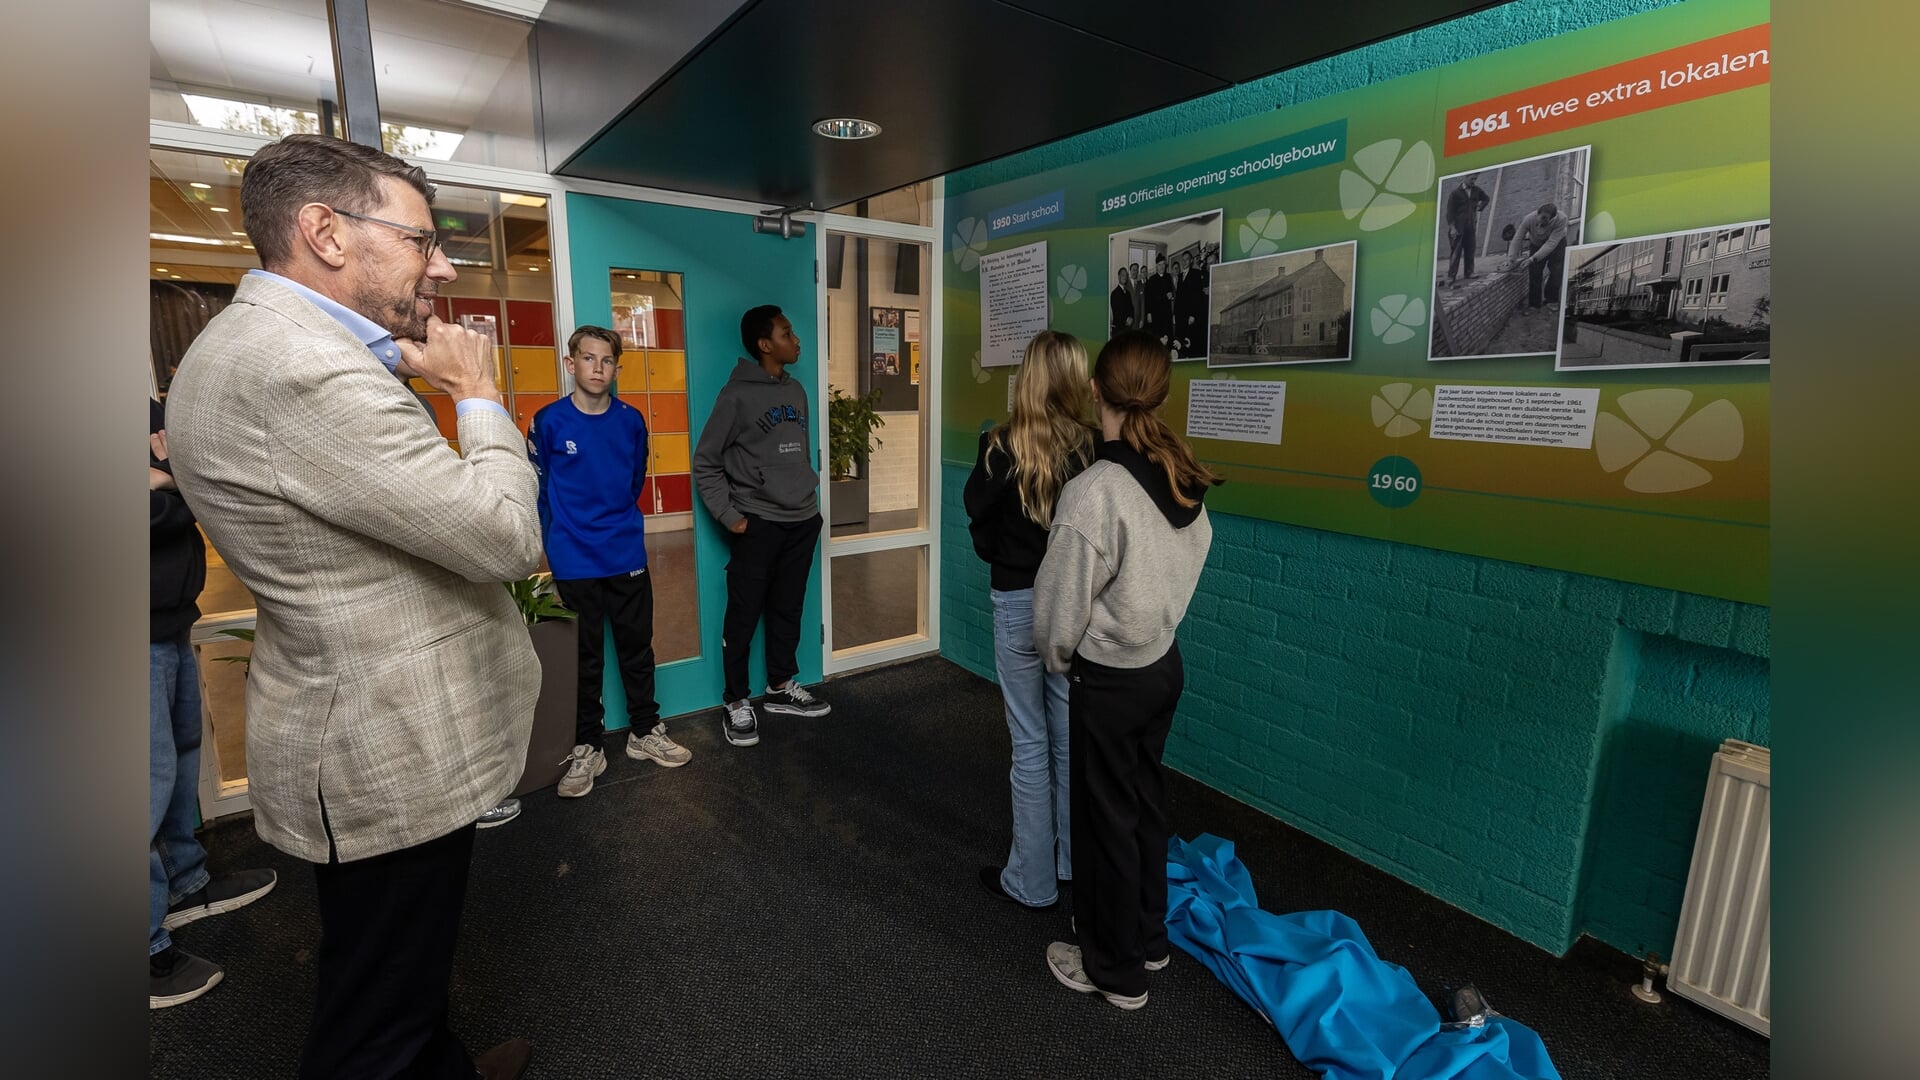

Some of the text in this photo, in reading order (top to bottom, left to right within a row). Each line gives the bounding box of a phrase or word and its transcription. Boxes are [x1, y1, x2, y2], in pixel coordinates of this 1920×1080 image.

[1457, 49, 1770, 140] 1961 Twee extra lokalen
[1101, 138, 1337, 212] 1955 Officiële opening schoolgebouw
[992, 201, 1060, 230] 1950 Start school
[1372, 474, 1417, 492] 1960
